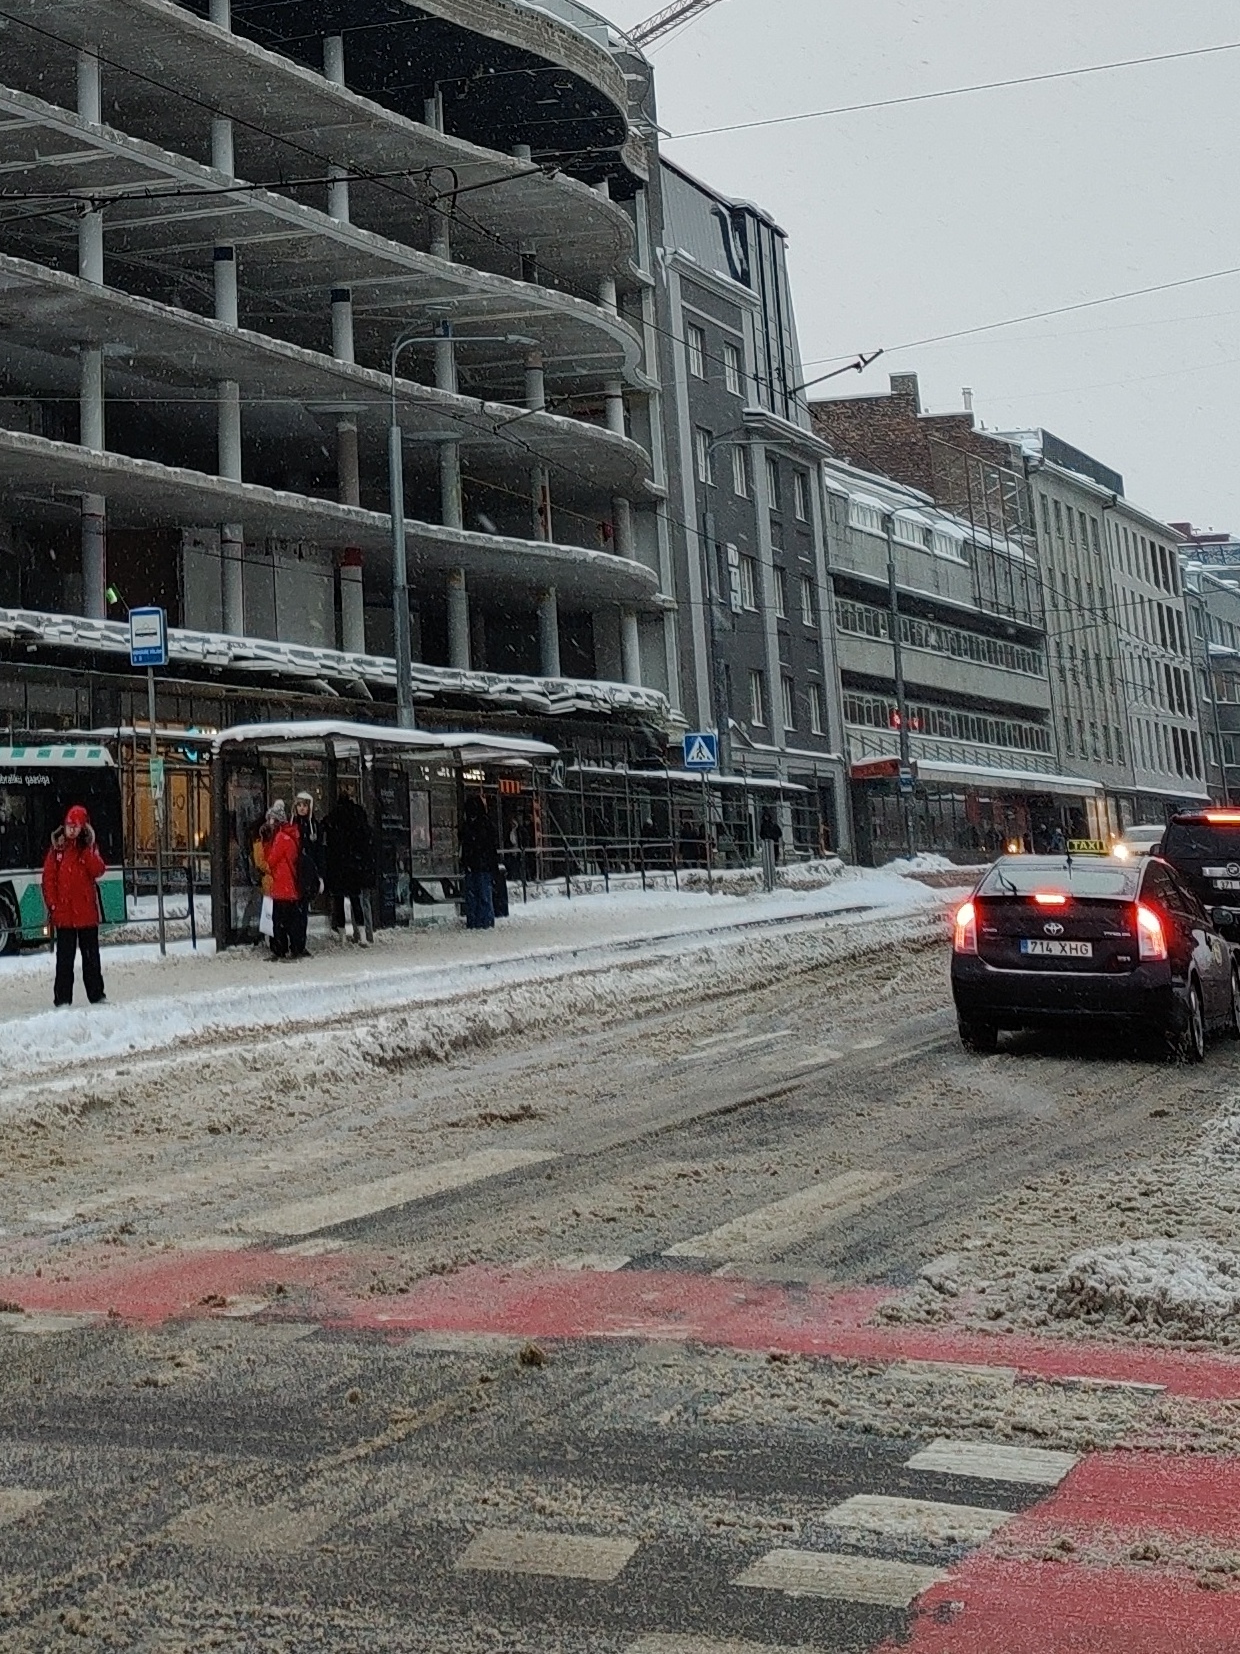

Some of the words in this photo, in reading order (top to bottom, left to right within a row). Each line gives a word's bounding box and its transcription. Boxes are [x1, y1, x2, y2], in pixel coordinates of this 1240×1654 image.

[1073, 840, 1100, 851] TAXI
[1030, 940, 1053, 954] 714
[1060, 941, 1089, 956] XHG
